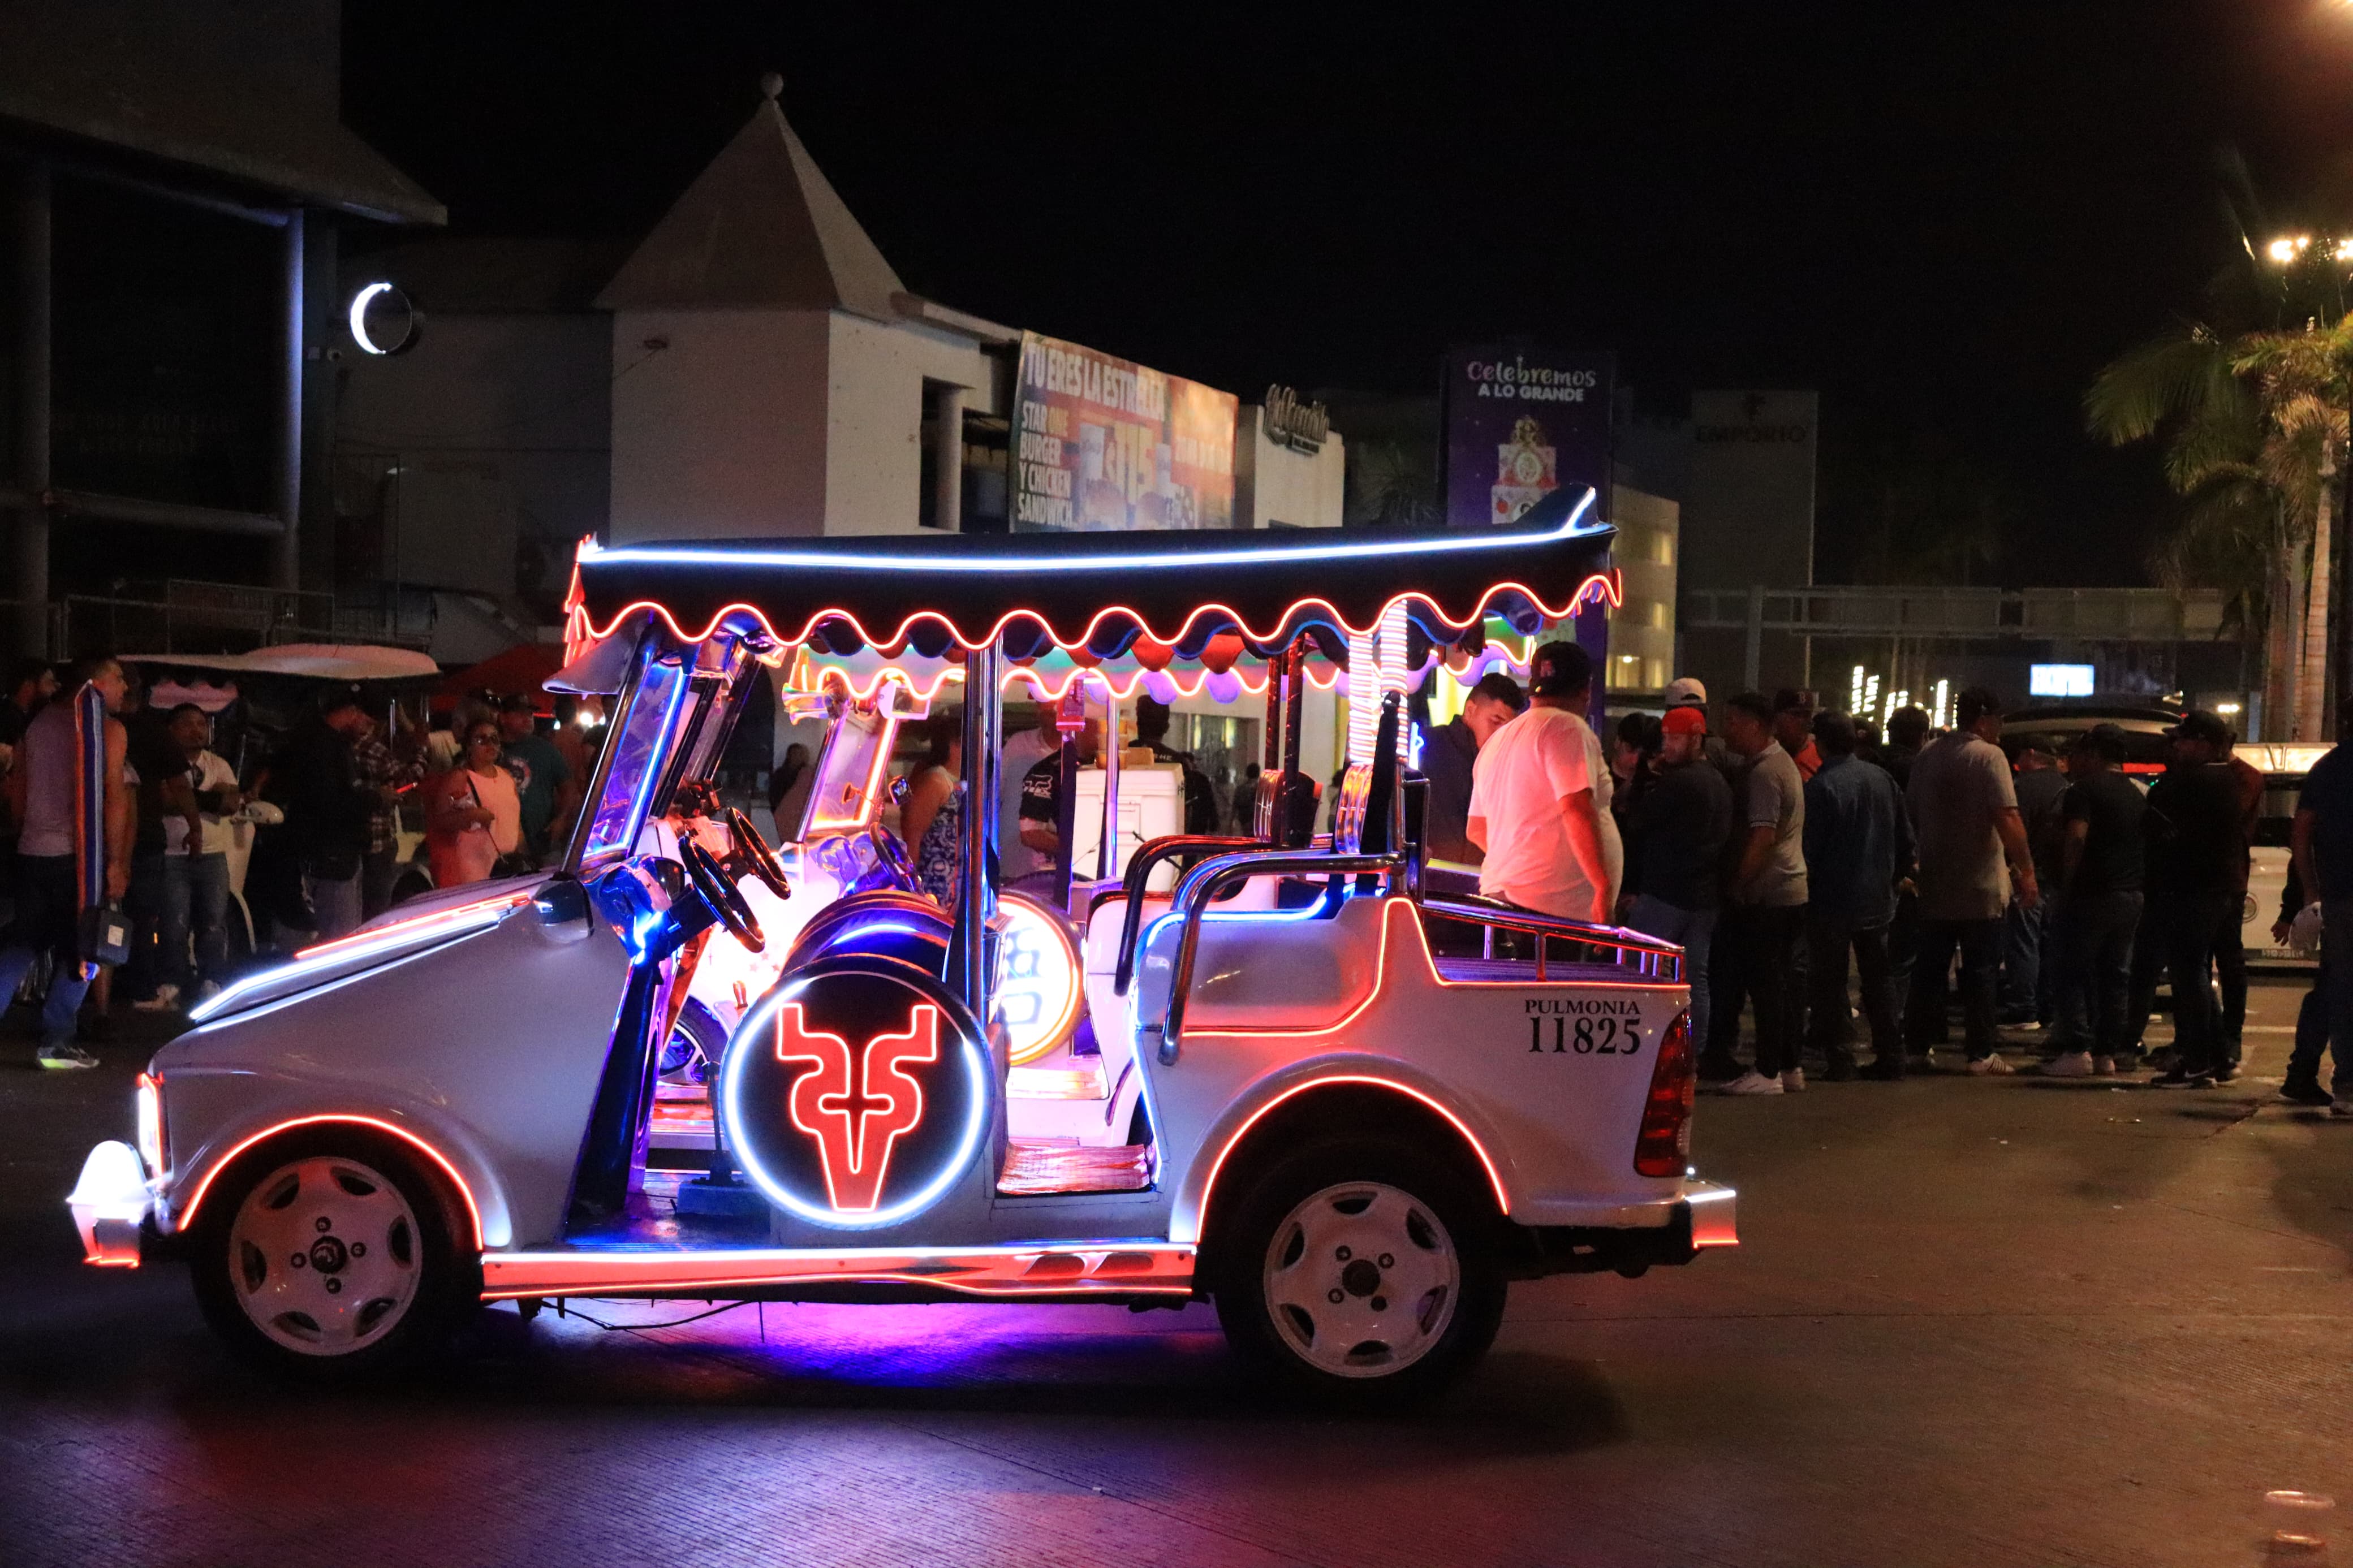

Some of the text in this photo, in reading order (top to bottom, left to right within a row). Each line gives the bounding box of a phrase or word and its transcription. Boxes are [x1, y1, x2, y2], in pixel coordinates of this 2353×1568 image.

[1026, 343, 1165, 421] TU ERES LA ESTRELLA
[1467, 357, 1597, 388] Celebremos
[1478, 385, 1585, 401] A LO GRANDE
[1021, 400, 1048, 433] STAR
[1020, 431, 1061, 467] BURGER
[1695, 425, 1807, 443] EMPORIO
[1019, 461, 1071, 499] Y CHICKEN
[1018, 493, 1072, 527] SANDWICH
[1525, 999, 1641, 1014] PULMONIA
[1528, 1017, 1641, 1055] 11825
